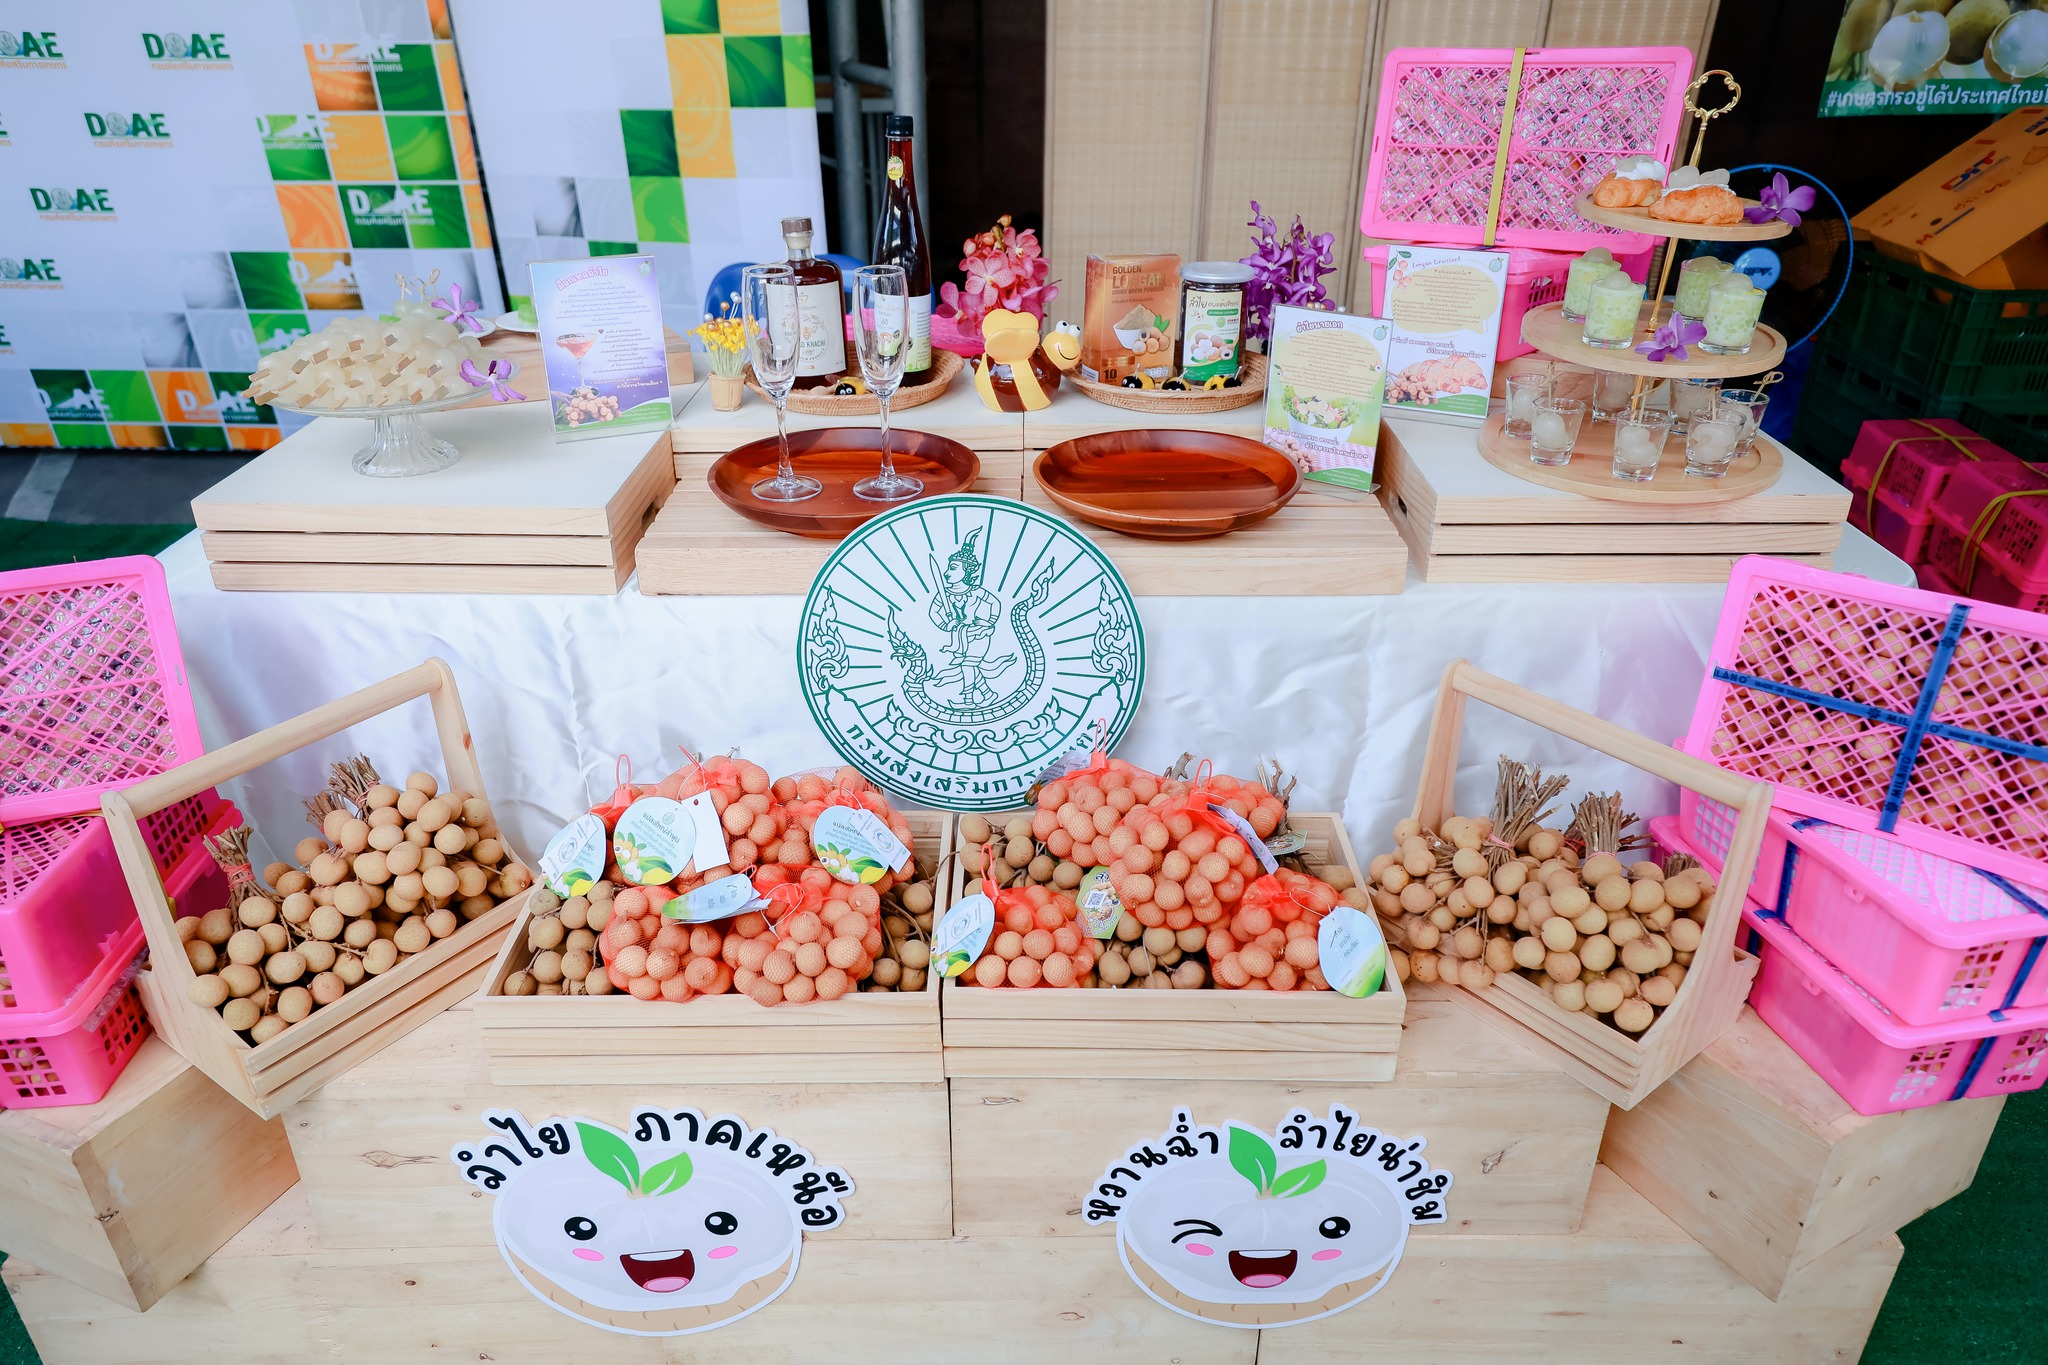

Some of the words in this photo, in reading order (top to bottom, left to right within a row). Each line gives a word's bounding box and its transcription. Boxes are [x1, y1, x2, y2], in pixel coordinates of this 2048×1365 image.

[1112, 265, 1142, 274] GOLDEN
[1112, 272, 1166, 289] LOGAN
[1103, 369, 1117, 380] 10
[1885, 713, 1943, 736] MILO
[846, 718, 1102, 796] กรมส่งเสริมการตร
[455, 1115, 571, 1191] ลำไย
[634, 1111, 850, 1227] ภาคเหนือ
[1086, 1111, 1220, 1221] หวานฉ่ำ
